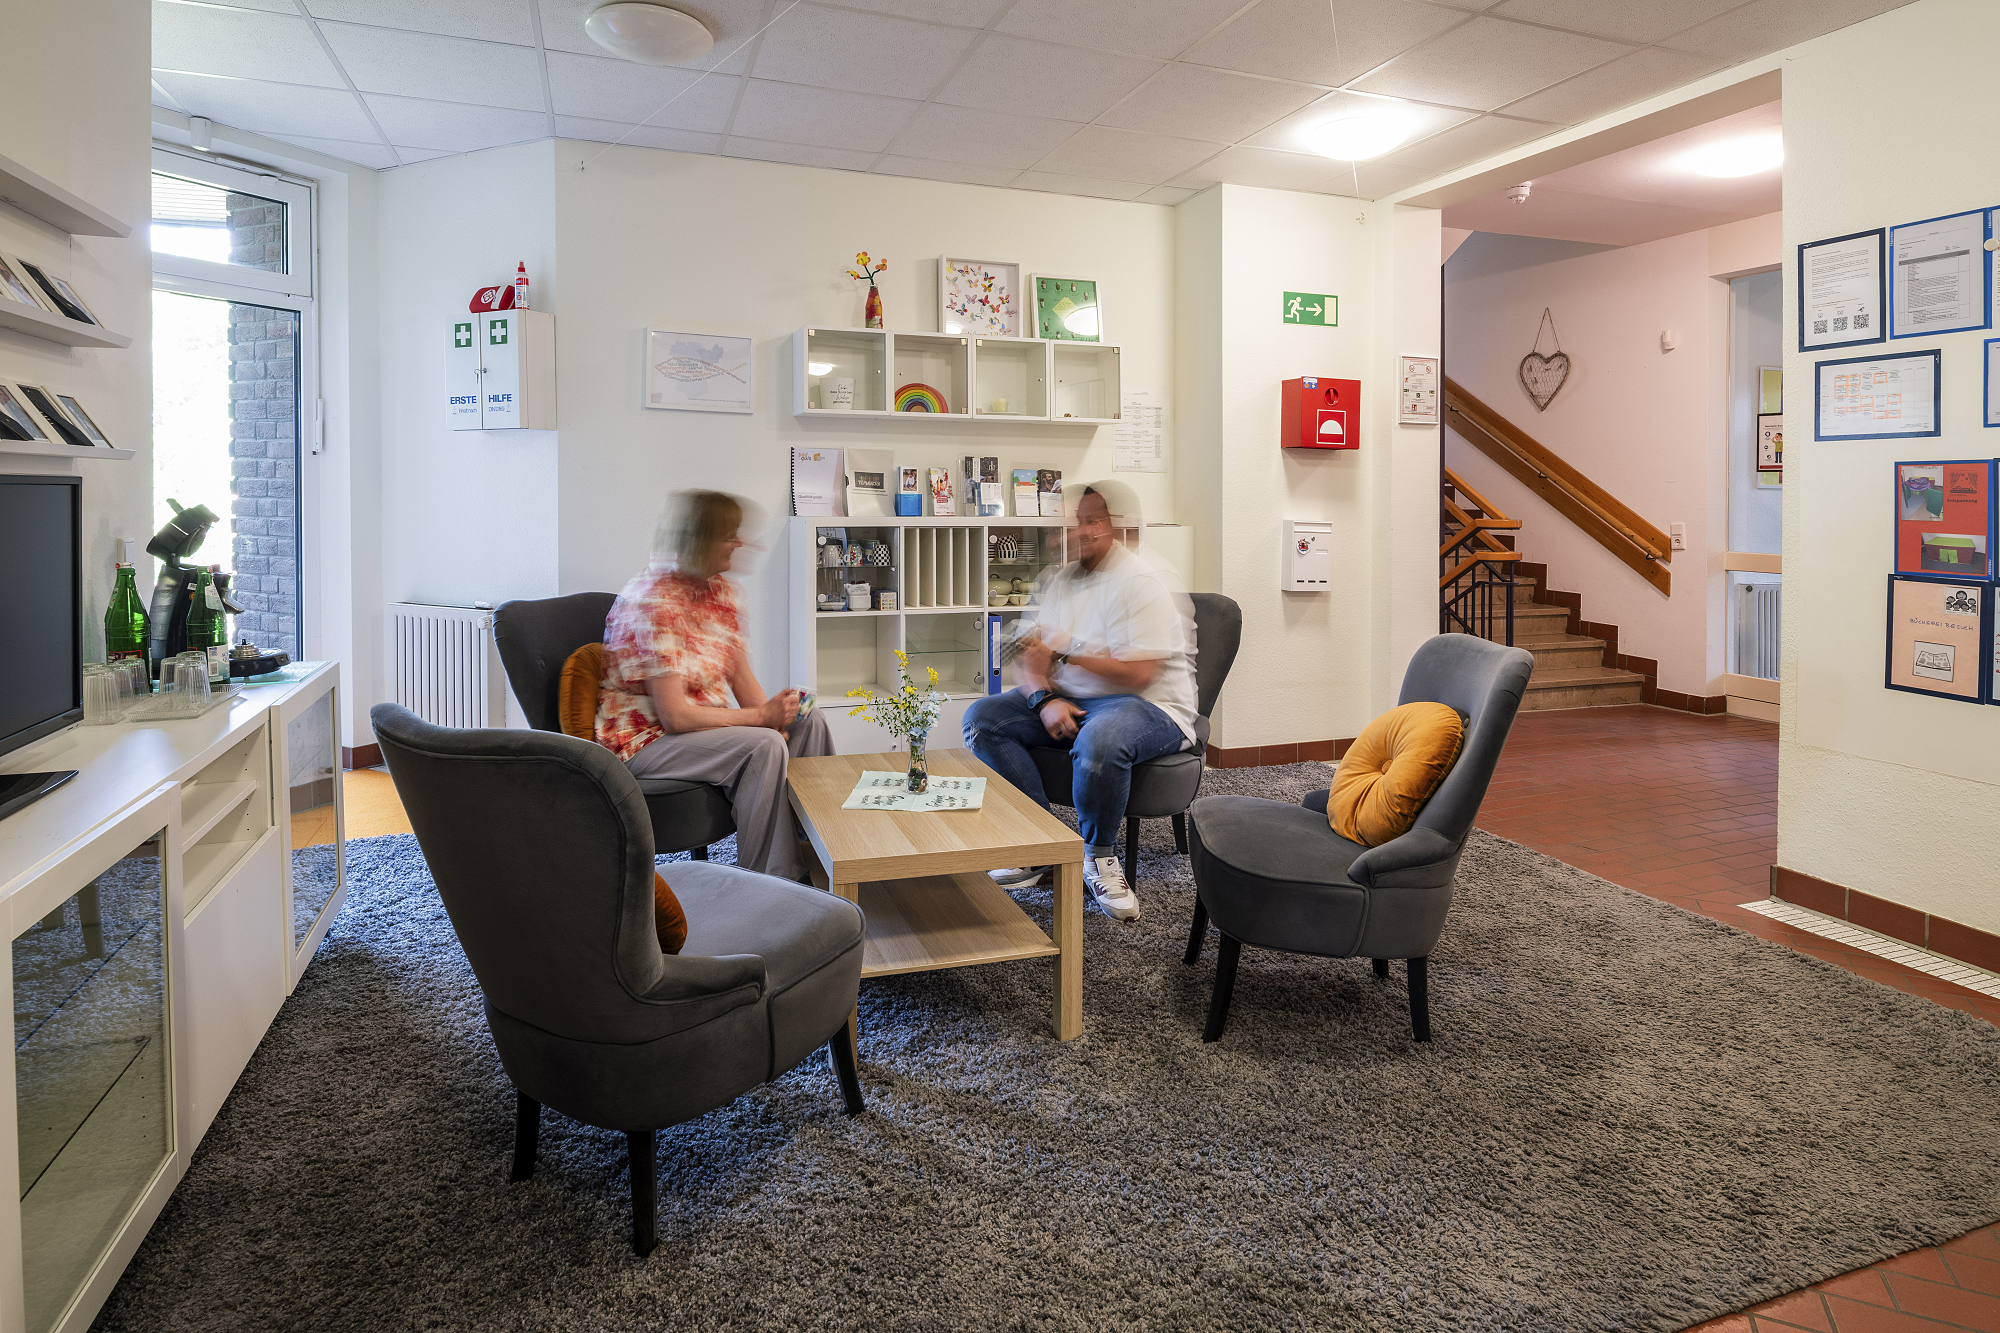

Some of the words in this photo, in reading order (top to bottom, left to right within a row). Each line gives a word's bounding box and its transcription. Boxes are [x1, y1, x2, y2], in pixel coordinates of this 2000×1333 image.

[450, 396, 477, 404] ERSTE
[488, 394, 512, 403] HILFE
[1909, 617, 1943, 628] BÜCHEREI
[1945, 622, 1974, 631] BESUCH
